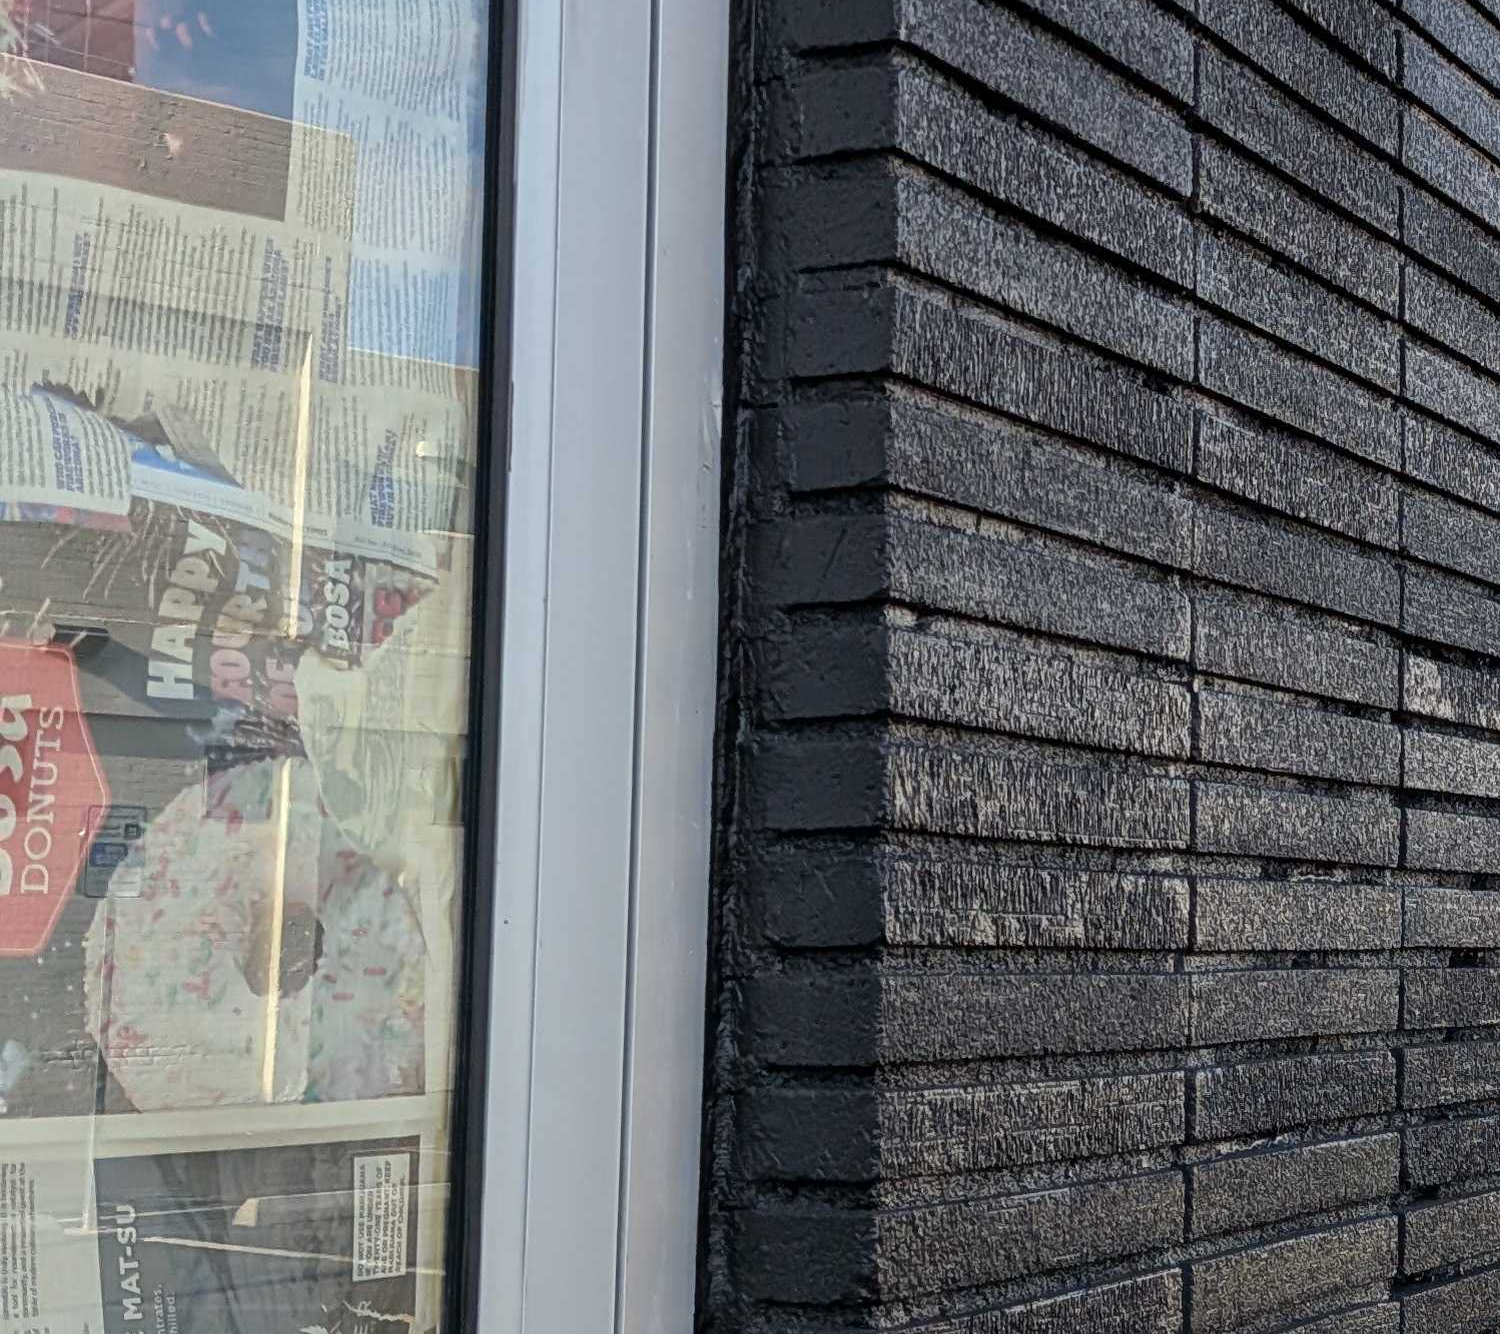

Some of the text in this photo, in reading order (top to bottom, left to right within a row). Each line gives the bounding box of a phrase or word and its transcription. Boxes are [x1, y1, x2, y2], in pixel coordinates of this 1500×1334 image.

[52, 436, 65, 490] WHO CAN
[61, 426, 75, 492] FIREWORKS
[70, 435, 84, 493] ARIZONA?
[146, 519, 229, 699] HAPPY
[323, 559, 352, 651] BOSA
[20, 705, 65, 895] DONUTS
[115, 1204, 143, 1321] MAT-SU
